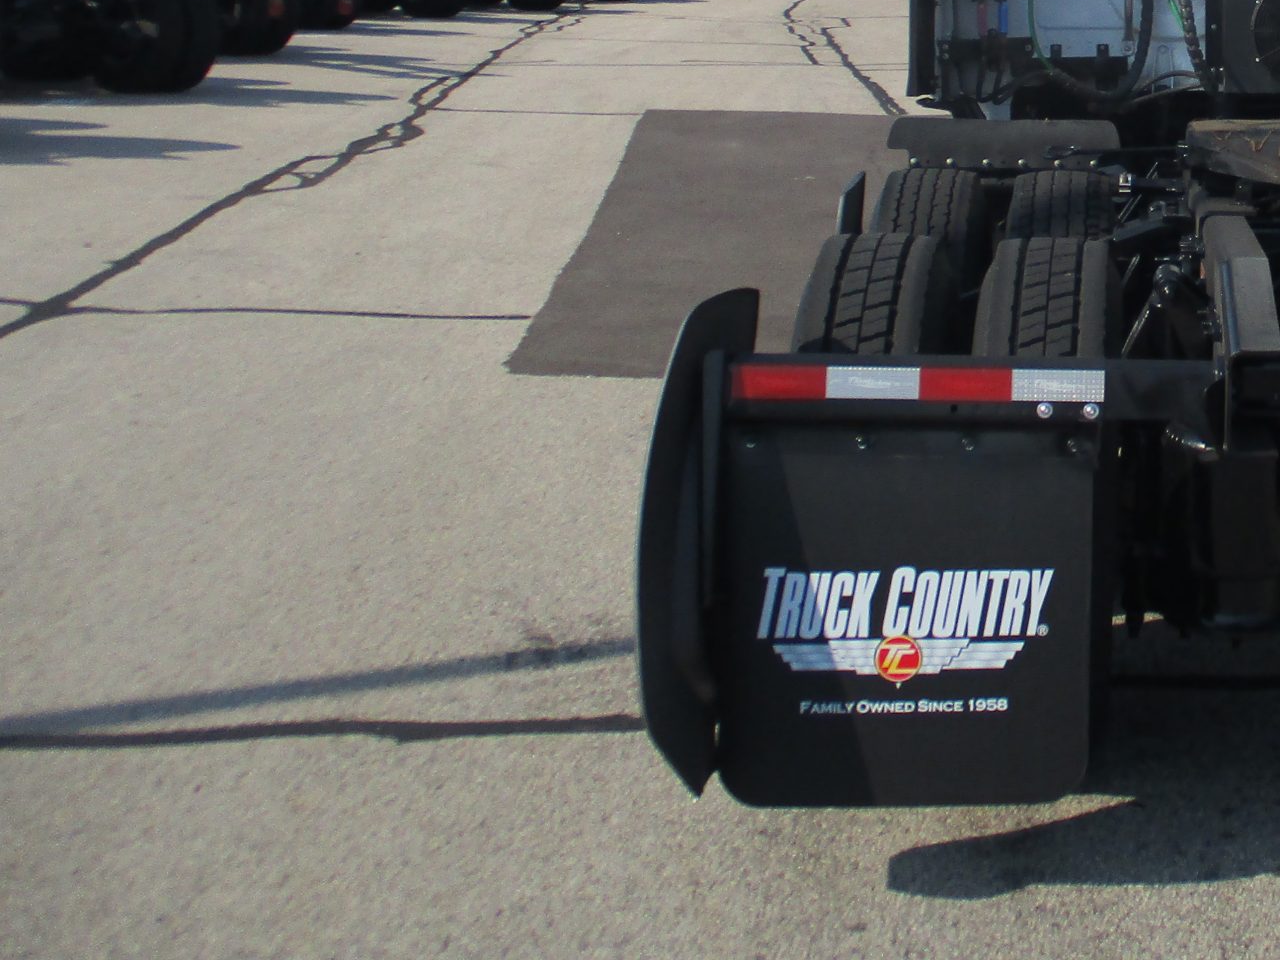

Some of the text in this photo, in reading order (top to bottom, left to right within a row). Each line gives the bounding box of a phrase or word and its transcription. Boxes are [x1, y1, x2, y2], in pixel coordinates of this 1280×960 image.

[757, 566, 1054, 640] TRUCK COUNTRY
[800, 697, 1008, 715] FAMILY OWNED SINCE 1958
